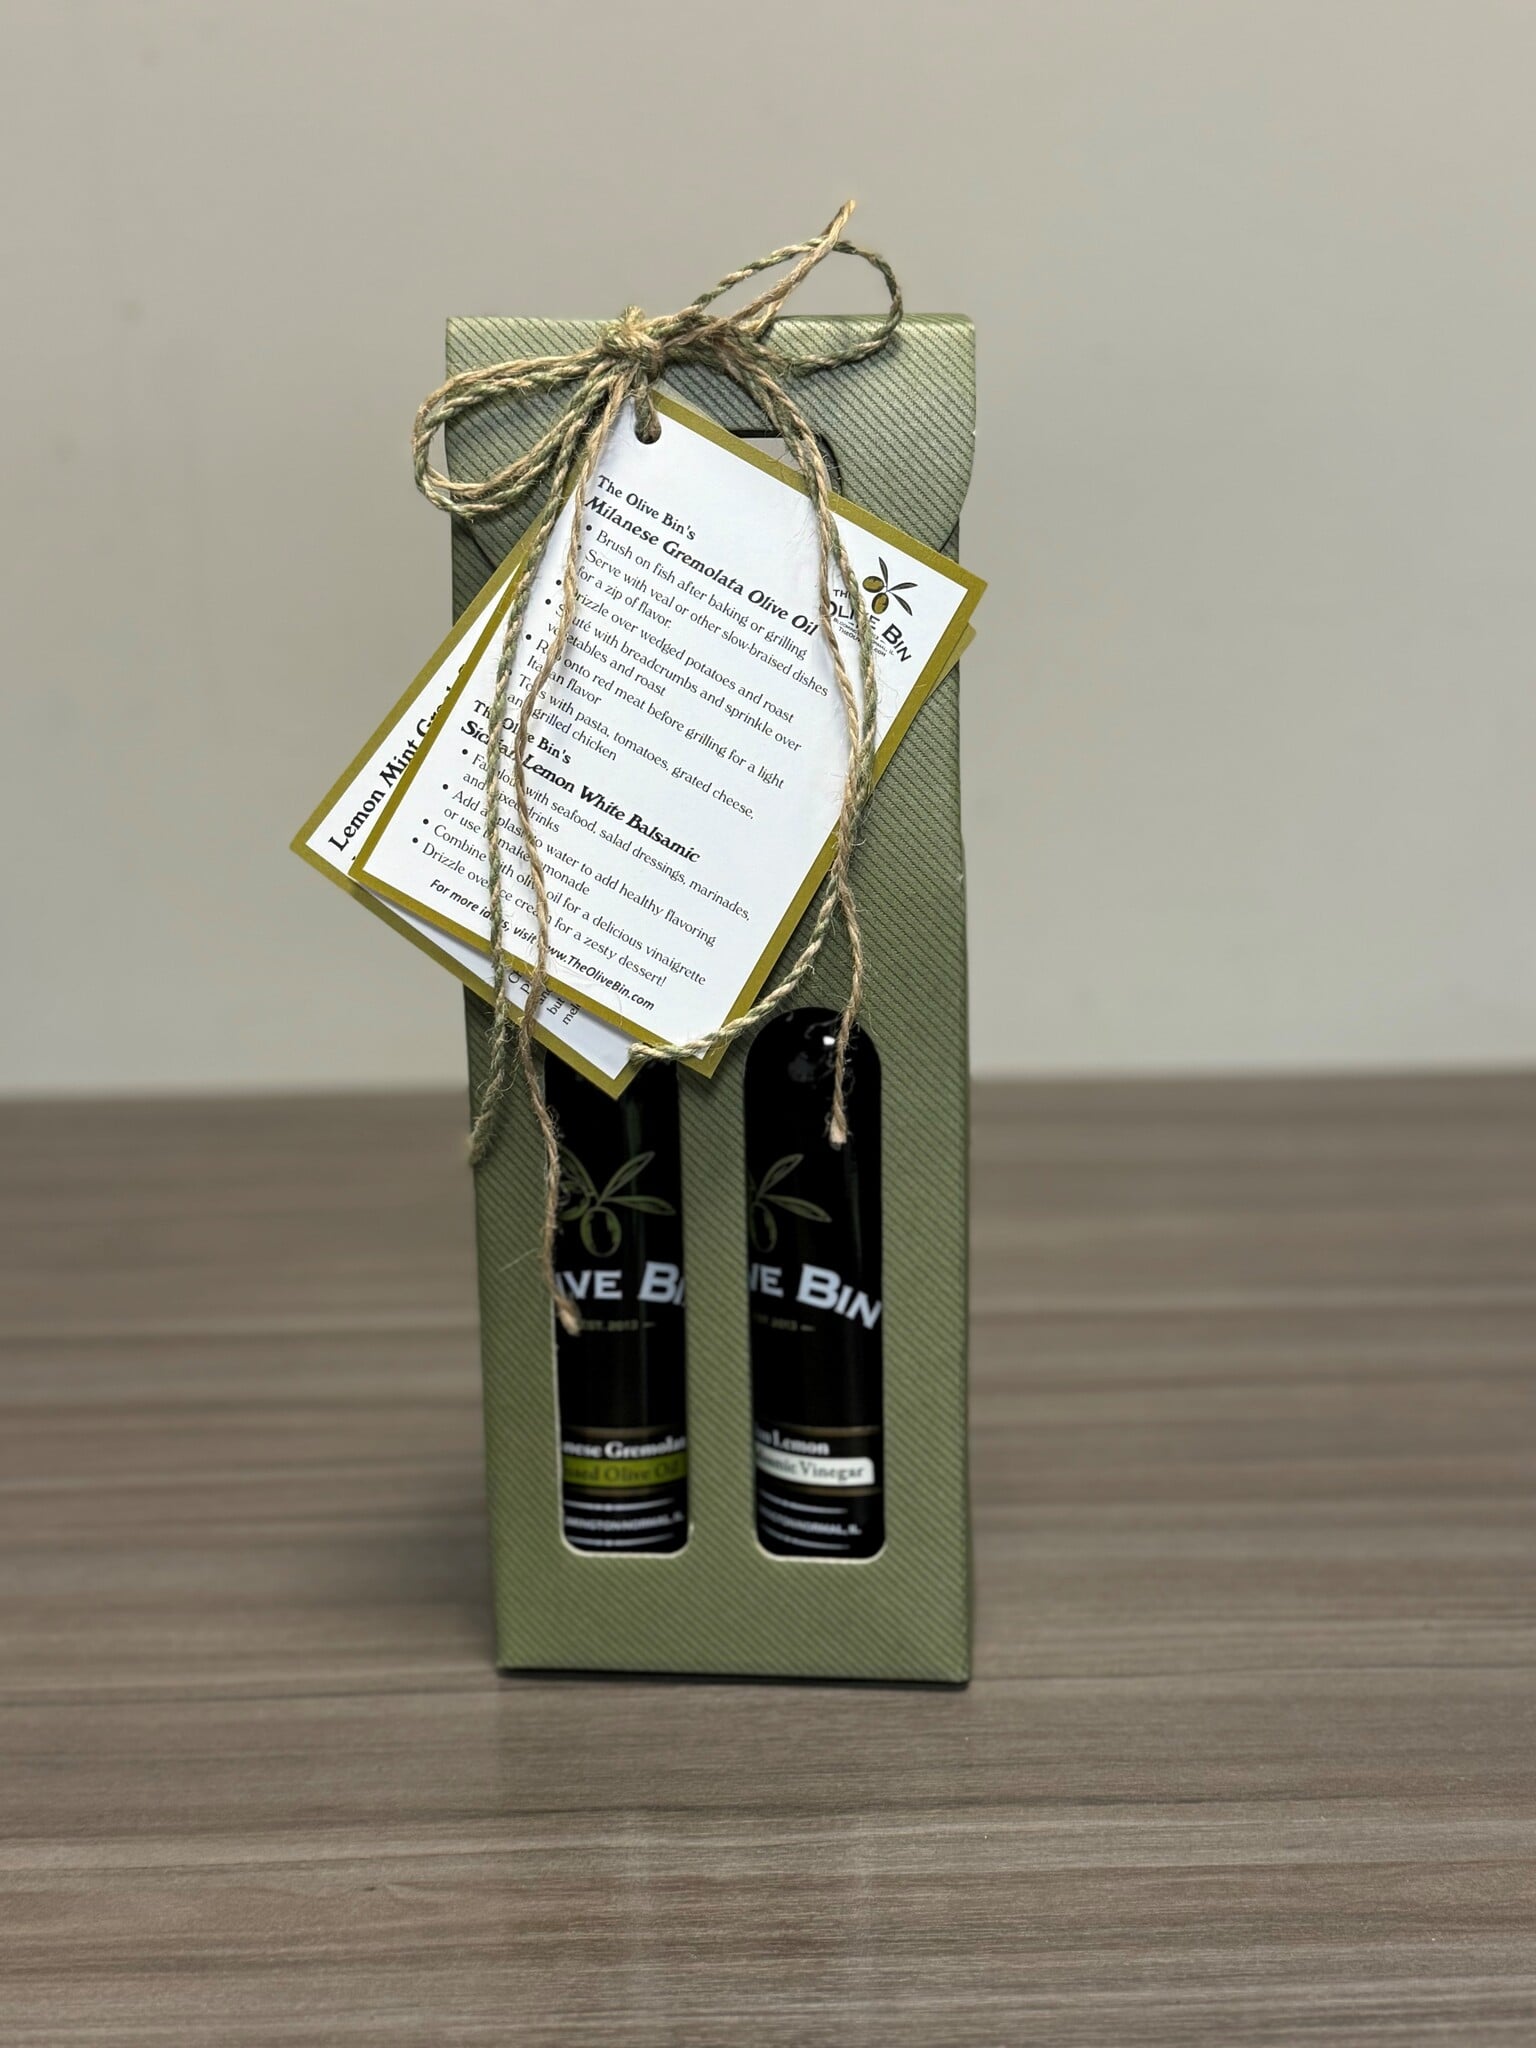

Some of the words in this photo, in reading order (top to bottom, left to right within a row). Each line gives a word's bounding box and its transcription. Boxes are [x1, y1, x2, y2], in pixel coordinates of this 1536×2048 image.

[596, 474, 622, 498] The
[625, 492, 659, 519] Olive
[660, 512, 695, 540] Bin's
[575, 565, 595, 582] for
[594, 580, 602, 589] a
[604, 585, 622, 600] zip
[624, 596, 640, 608] of
[637, 600, 671, 628] flavor.
[585, 497, 659, 546] Milanese
[662, 540, 743, 595] Gremolata
[747, 589, 788, 620] Olive
[791, 614, 821, 636] Oil
[595, 529, 632, 559] Brush
[634, 555, 650, 569] on
[652, 562, 675, 584] fish
[676, 580, 707, 600] after
[707, 593, 749, 627] baking
[750, 622, 765, 633] or
[763, 631, 807, 661] grilling
[833, 588, 851, 599] TH
[583, 548, 621, 577] Serve
[623, 573, 647, 593] with
[650, 588, 675, 608] veal
[674, 604, 689, 615] or
[689, 612, 721, 633] other
[720, 630, 793, 675] slow-braised
[791, 669, 828, 696] dishes
[610, 614, 638, 632] over
[640, 629, 686, 660] wedged
[683, 656, 736, 690] potatoes
[737, 686, 763, 704] and
[762, 700, 794, 723] roast
[882, 623, 912, 662] BIN
[473, 699, 495, 719] Th
[499, 717, 535, 743] Ole
[536, 736, 571, 764] Bin's
[505, 693, 525, 708] an
[530, 708, 572, 734] grilled
[571, 730, 616, 761] chicken
[526, 654, 568, 686] Itaan
[565, 677, 602, 704] flavor
[555, 603, 591, 632] Suté
[594, 627, 618, 648] with
[620, 640, 698, 693] breadcrumbs
[699, 689, 725, 708] and
[724, 703, 773, 736] sprinkle
[774, 732, 802, 751] over
[561, 655, 590, 678] onto
[591, 674, 615, 691] red
[613, 687, 646, 710] meat
[646, 702, 684, 732] before
[684, 728, 727, 758] grilling
[727, 748, 747, 766] for
[746, 763, 755, 773] a
[757, 765, 784, 789] light
[609, 659, 635, 678] and
[634, 673, 666, 696] roast
[328, 791, 386, 852] Lemon
[379, 737, 419, 789] Mint
[462, 773, 488, 791] and
[519, 673, 546, 699] Tos
[549, 695, 573, 716] with
[574, 711, 609, 737] pasta,
[613, 731, 668, 771] tomatoes,
[670, 767, 712, 793] grated
[712, 789, 753, 819] cheese,
[443, 808, 459, 820] or
[459, 817, 481, 833] use
[495, 838, 532, 862] make
[543, 863, 590, 896] monade
[521, 753, 576, 793] Lemon
[579, 784, 625, 820] White
[624, 813, 700, 863] Balsamic
[522, 786, 549, 806] with
[550, 801, 597, 834] seafood,
[598, 829, 632, 852] salad
[631, 846, 685, 885] dressings,
[688, 880, 749, 921] marinades,
[421, 842, 465, 874] Drizzle
[467, 871, 491, 889] ove
[497, 889, 512, 901] ce
[553, 916, 573, 934] for
[573, 931, 581, 941] a
[582, 936, 617, 960] zesty
[618, 954, 667, 987] dessert!
[432, 823, 487, 862] Combine
[496, 861, 514, 878] ith
[544, 891, 563, 904] oil
[561, 896, 581, 913] for
[581, 911, 590, 921] a
[592, 915, 643, 950] delicious
[646, 945, 706, 985] vinaigrette
[451, 790, 480, 811] Add
[493, 816, 529, 840] plas
[546, 844, 579, 867] water
[579, 863, 592, 876] to
[594, 872, 619, 890] add
[618, 882, 664, 916] healthy
[664, 908, 716, 947] flavoring
[429, 878, 450, 894] For
[448, 891, 479, 912] more
[512, 926, 539, 944] visit
[546, 945, 654, 1011] ww.TheOliveBin.com
[796, 1263, 881, 1330] BIN
[772, 1429, 831, 1456] Lemon
[799, 1460, 865, 1483] Vinegar
